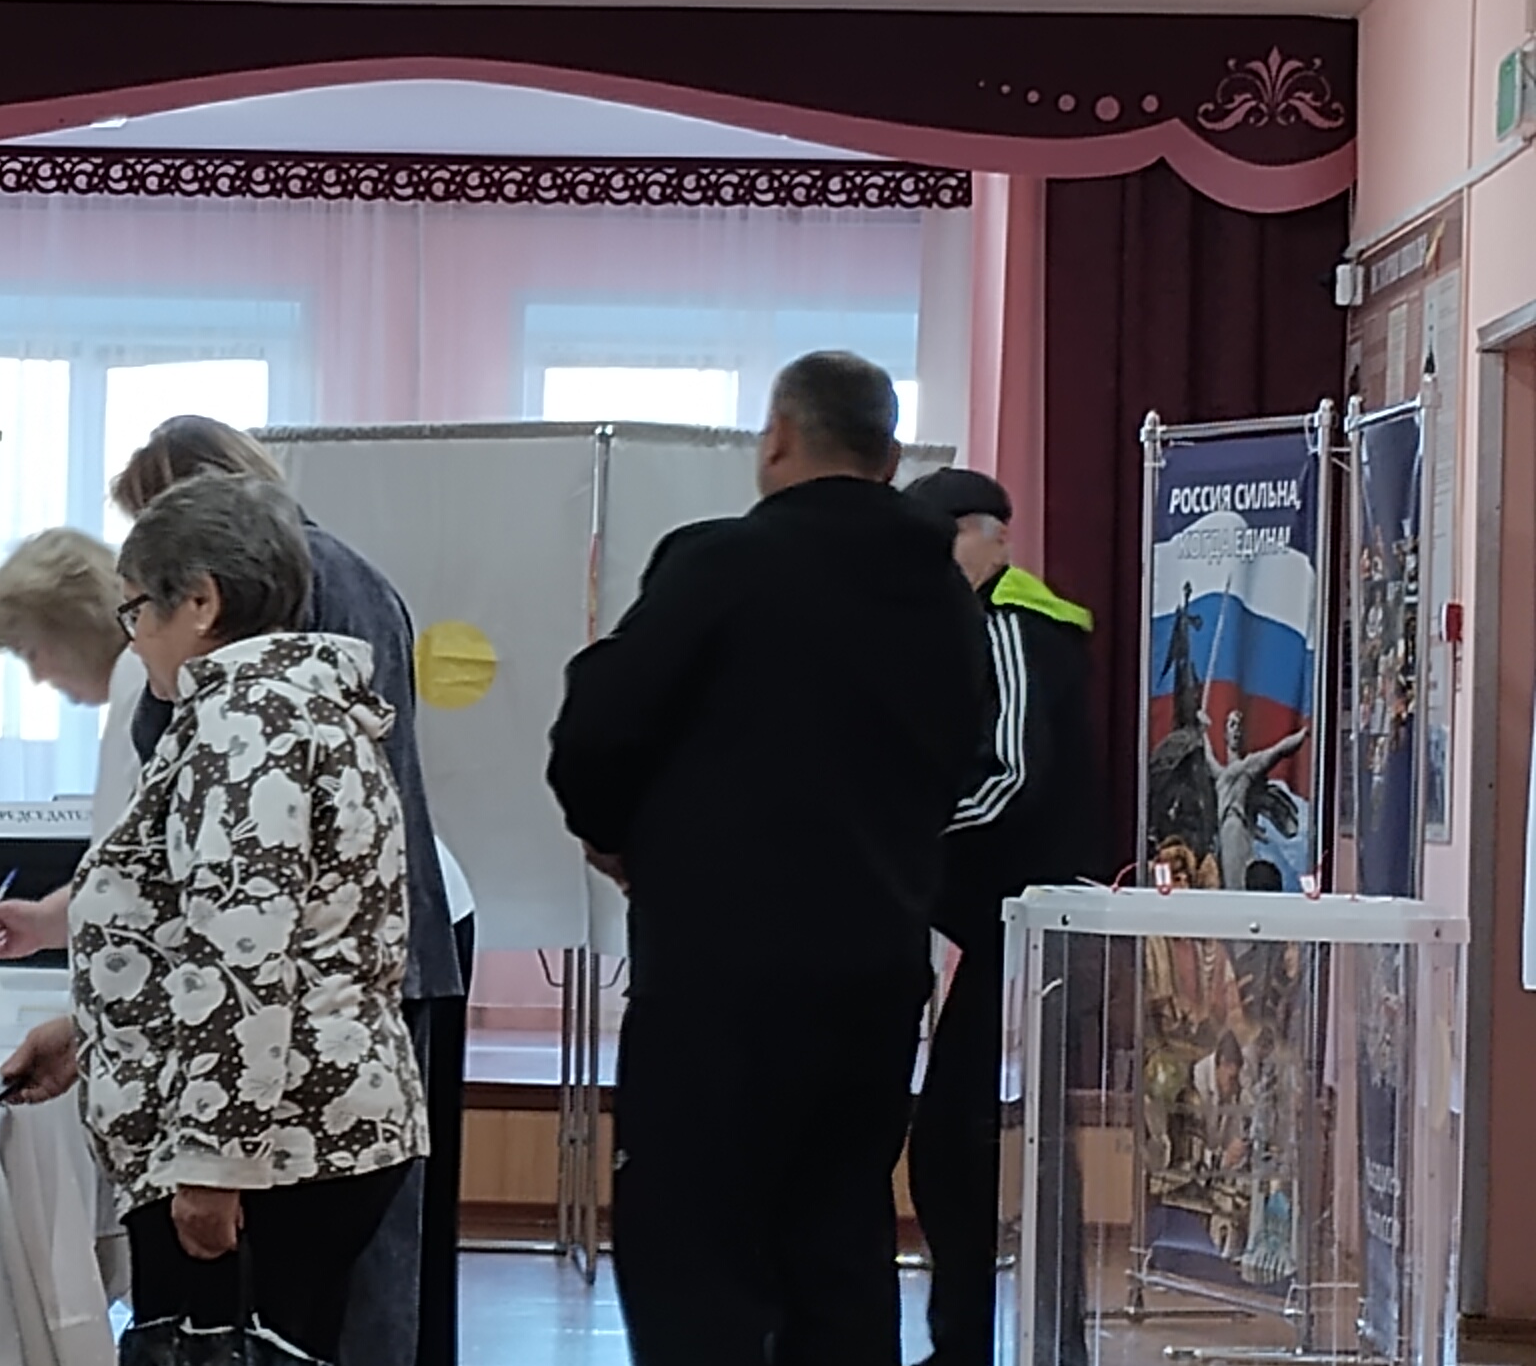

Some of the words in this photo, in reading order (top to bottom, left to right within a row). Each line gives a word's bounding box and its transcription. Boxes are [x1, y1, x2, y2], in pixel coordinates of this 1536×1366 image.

[1169, 484, 1231, 514] РОССИЯ
[1234, 479, 1302, 511] СИЛЬНА,
[1178, 528, 1233, 566] КОГДА
[1234, 525, 1291, 564] ЕДИНА!
